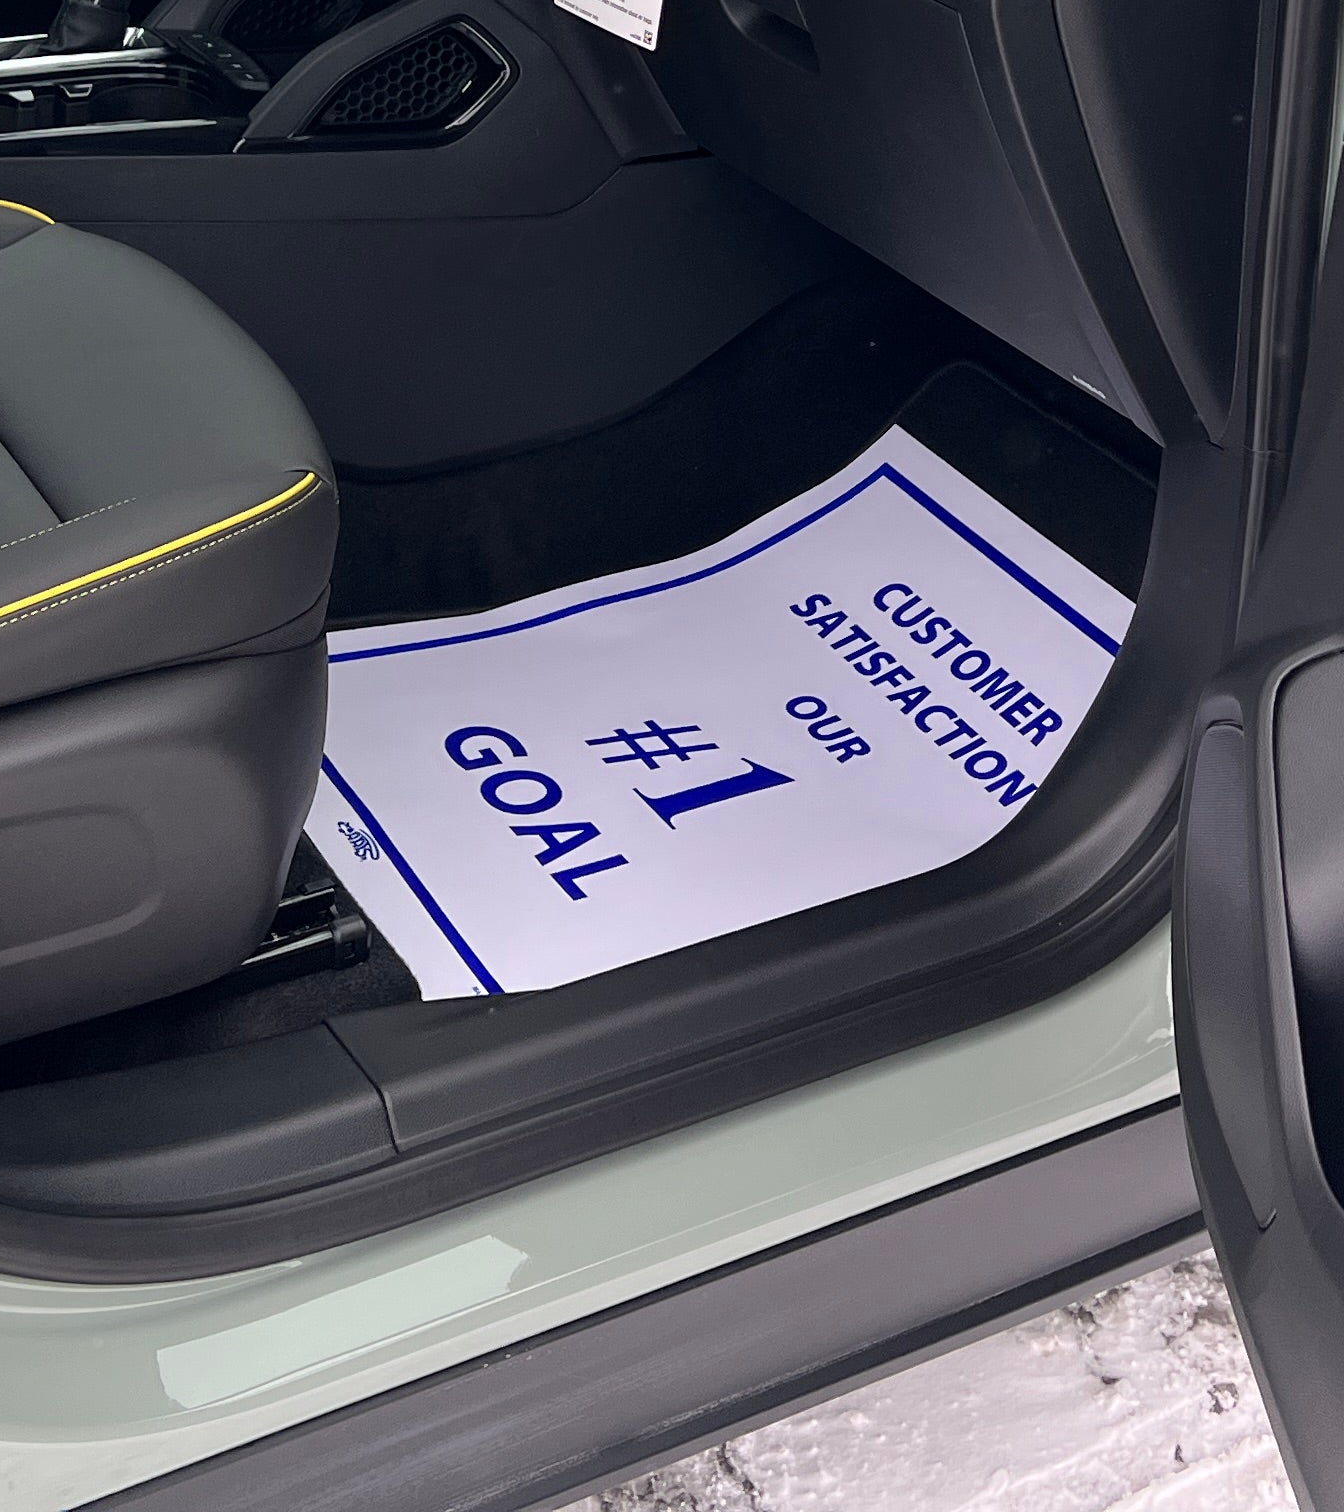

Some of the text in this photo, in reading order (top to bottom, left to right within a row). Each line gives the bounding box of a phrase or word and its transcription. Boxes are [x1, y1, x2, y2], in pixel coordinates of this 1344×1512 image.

[785, 695, 872, 764] OUR
[789, 593, 1038, 807] SATISFACTION
[873, 583, 1063, 747] CUSTOMER
[444, 725, 630, 901] GOAL
[584, 719, 796, 830] #1
